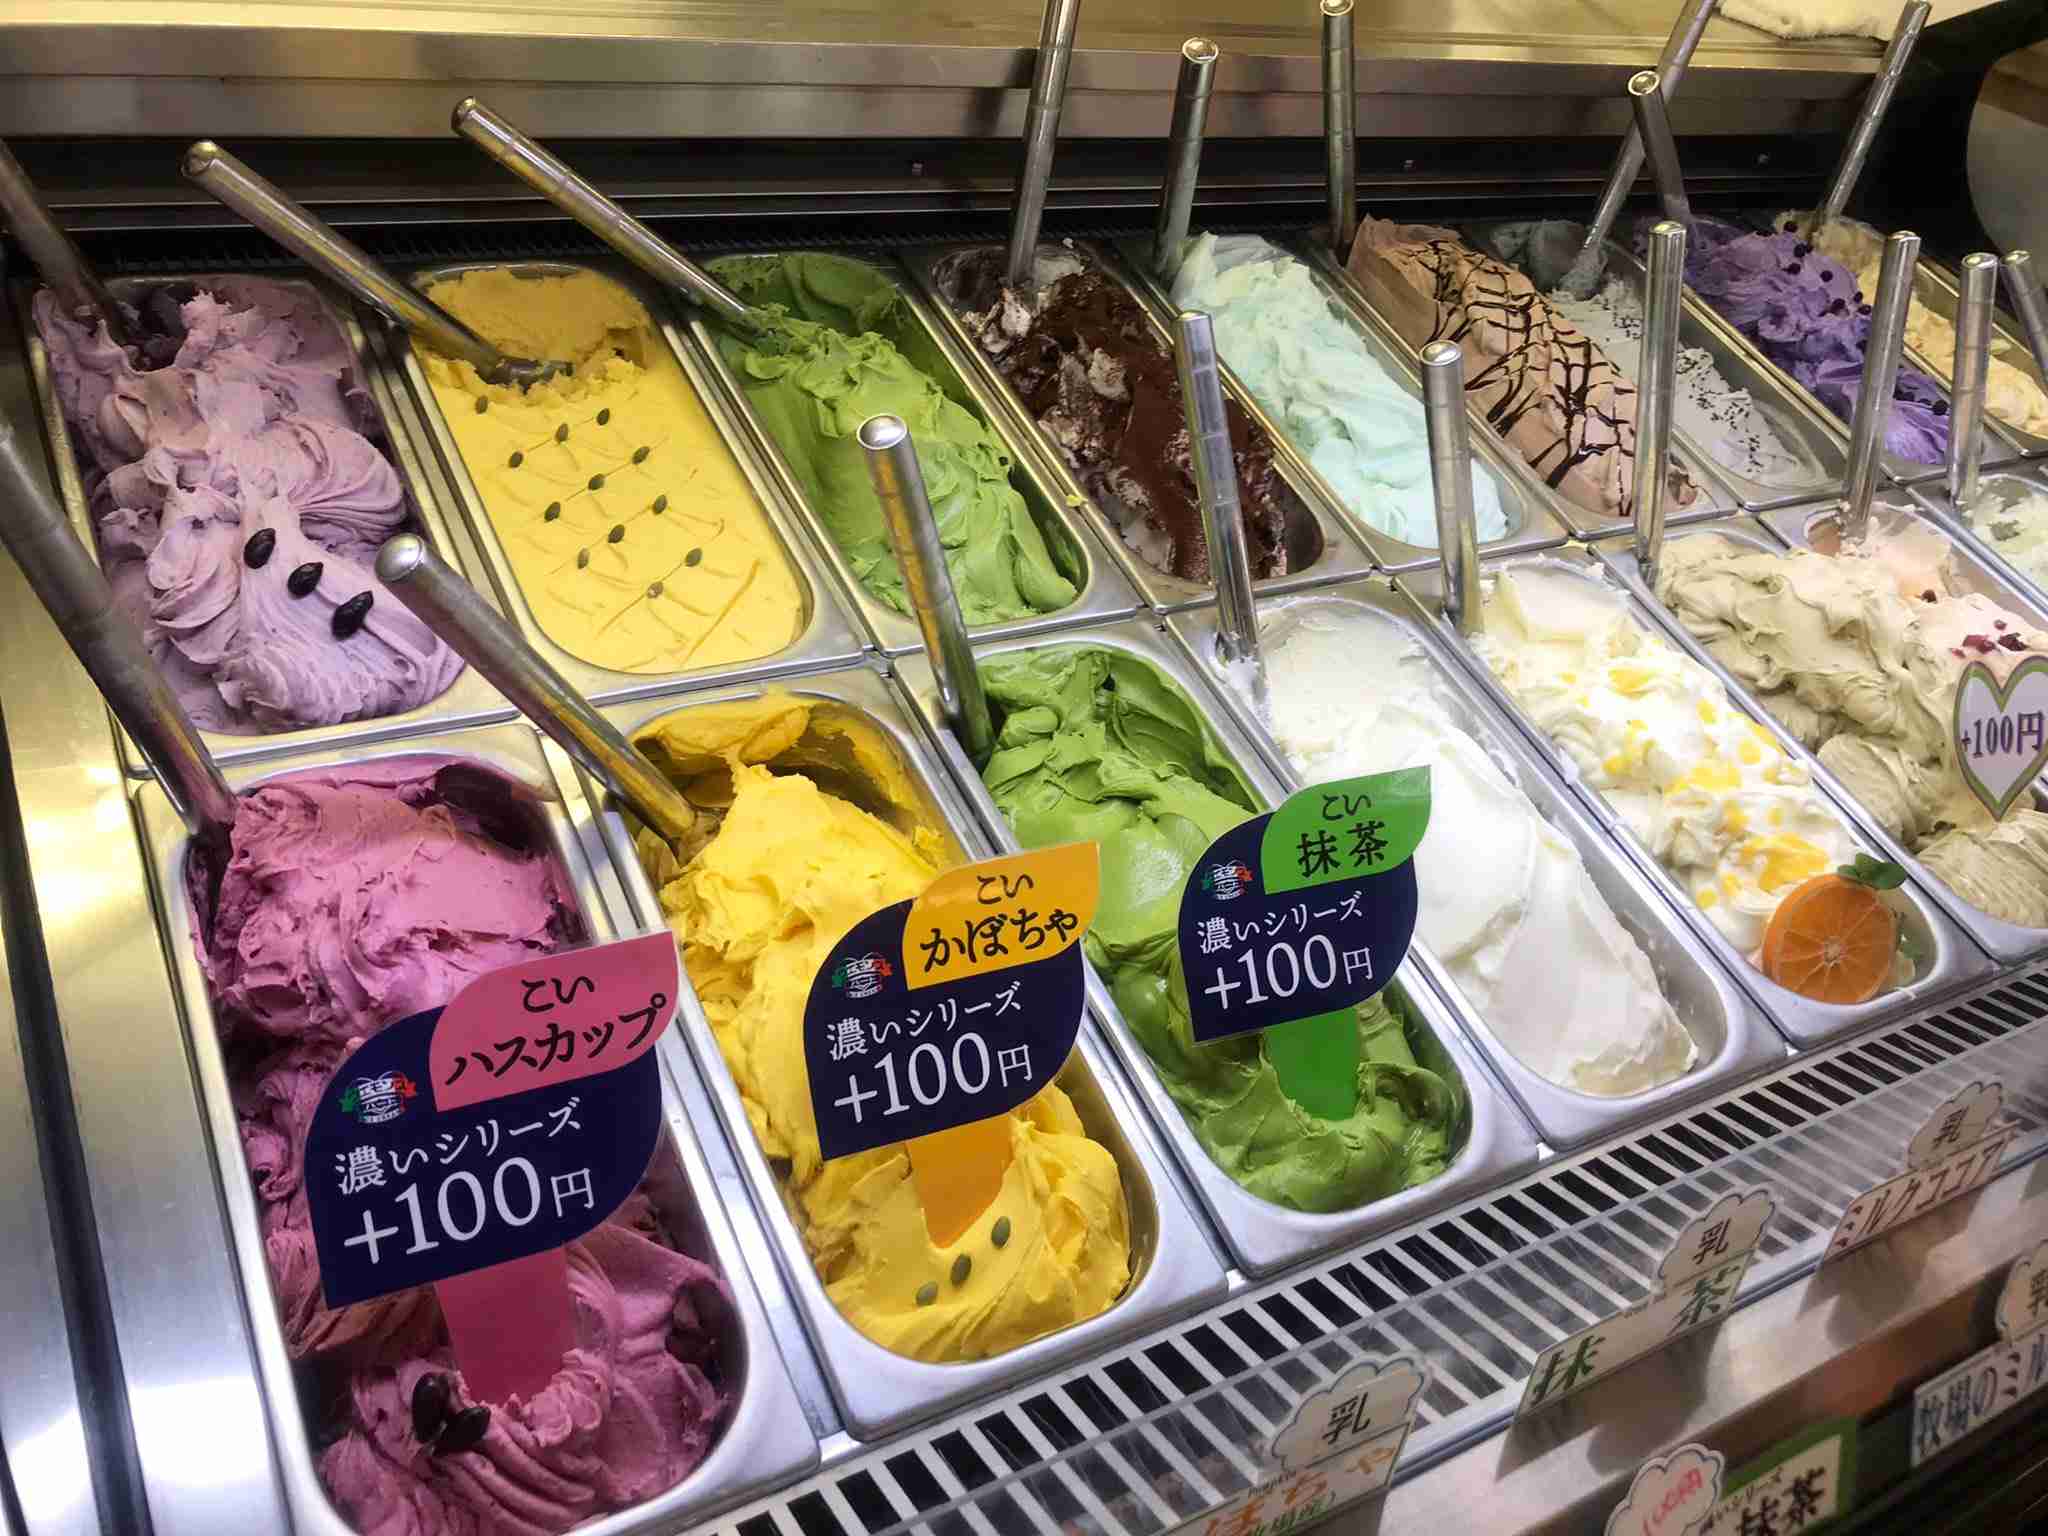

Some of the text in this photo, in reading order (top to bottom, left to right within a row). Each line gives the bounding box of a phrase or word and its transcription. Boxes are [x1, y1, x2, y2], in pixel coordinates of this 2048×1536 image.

[1961, 711, 2044, 759] +100円
[1321, 794, 1372, 821] こい
[1296, 820, 1389, 878] 抹茶
[976, 873, 1034, 905] こい
[919, 908, 1079, 973] かぼちゃ
[1197, 890, 1363, 954] 濃いシリーズ
[520, 975, 595, 1013] こい
[1204, 934, 1374, 1010] +100円
[445, 993, 667, 1086] ハスカップ
[826, 980, 1021, 1062] 濃いシリーズ
[834, 1032, 1033, 1123] +100円
[335, 1096, 582, 1195] 濃いシリーズ
[343, 1156, 596, 1264] +100円
[1692, 1218, 1732, 1264] 乳
[1322, 1391, 1371, 1445] 乳
